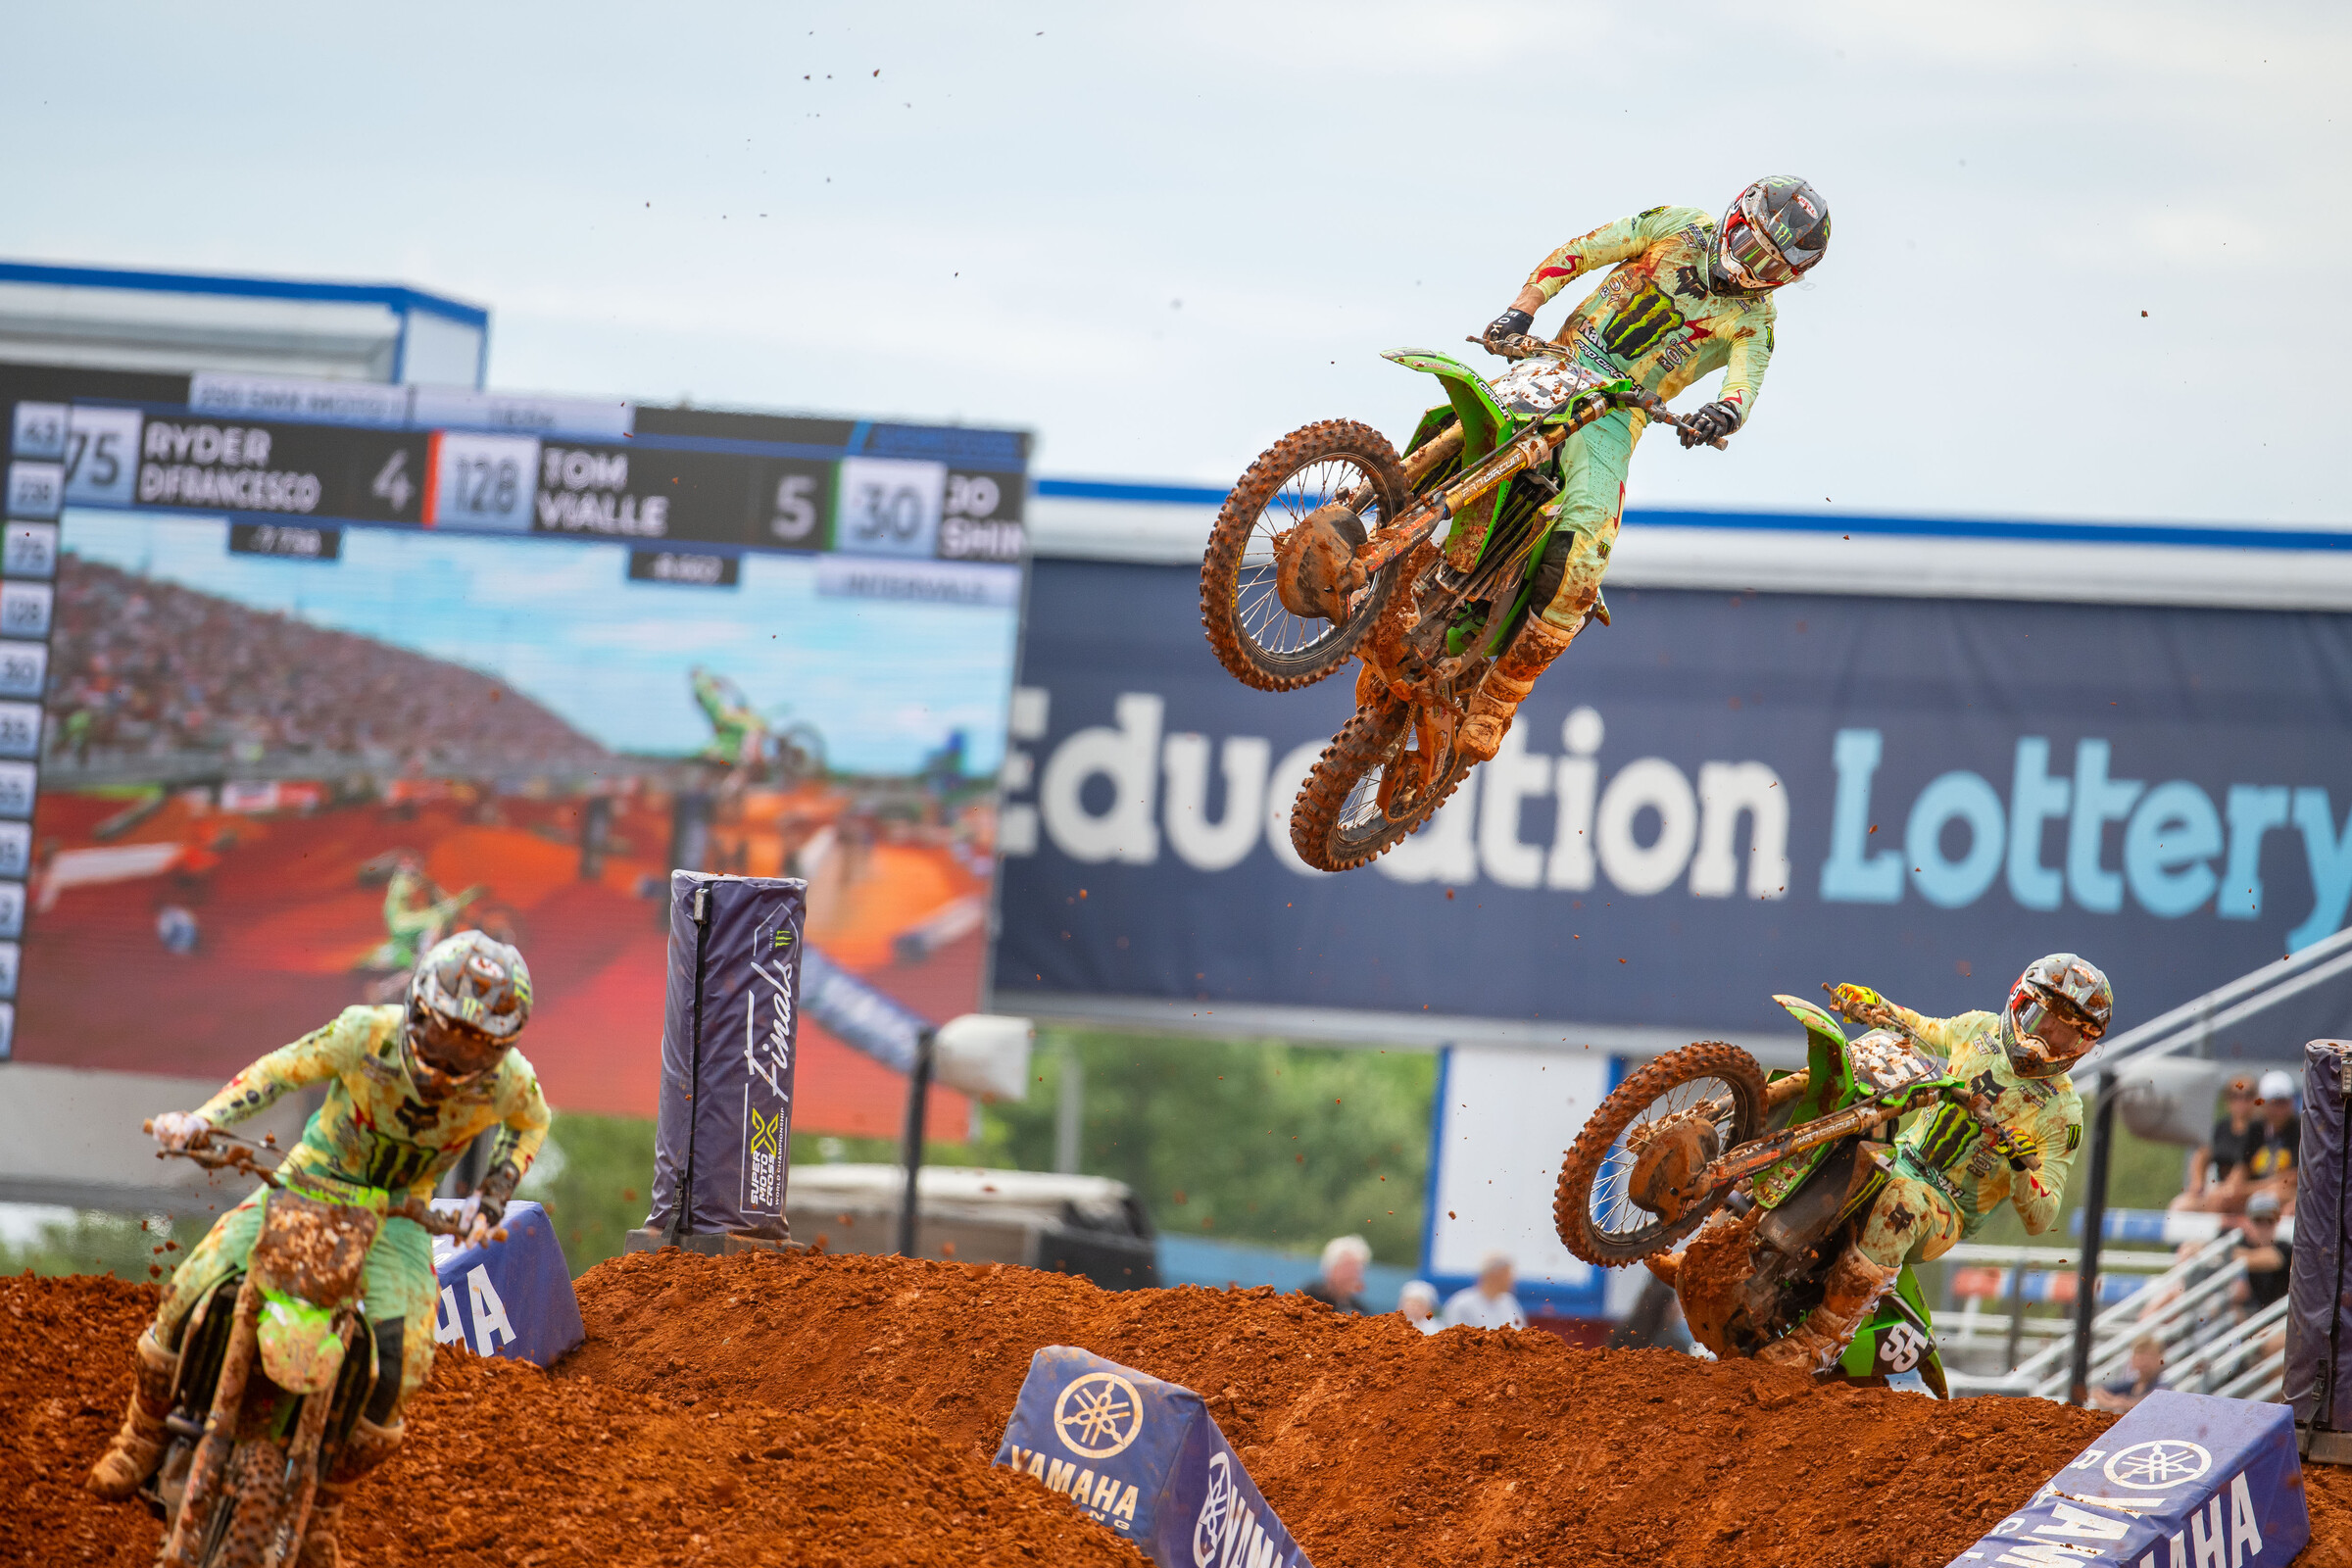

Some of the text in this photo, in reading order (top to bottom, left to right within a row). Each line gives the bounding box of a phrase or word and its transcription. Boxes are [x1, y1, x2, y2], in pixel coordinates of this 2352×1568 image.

[138, 462, 322, 515] DIFRANCESCO
[534, 489, 671, 539] VIALLE
[144, 420, 273, 468] RYDER
[370, 449, 416, 514] 4
[454, 452, 522, 515] 128
[541, 445, 629, 492] TOM
[769, 474, 818, 542] 5
[854, 483, 923, 543] 30
[1484, 454, 1523, 482] CIRCUIT
[1819, 727, 2352, 954] Lottery
[744, 958, 794, 1102] Finals
[776, 1106, 785, 1173] CHAMPIONSHIP
[1818, 1116, 1859, 1137] CIRCUIT
[750, 1150, 761, 1205] SUPER
[759, 1152, 768, 1203] MOTO
[765, 1152, 776, 1207] CROSS
[1879, 1320, 1930, 1373] 55
[1011, 1445, 1140, 1521] YAMAHA
[2138, 1470, 2264, 1568] AHA
